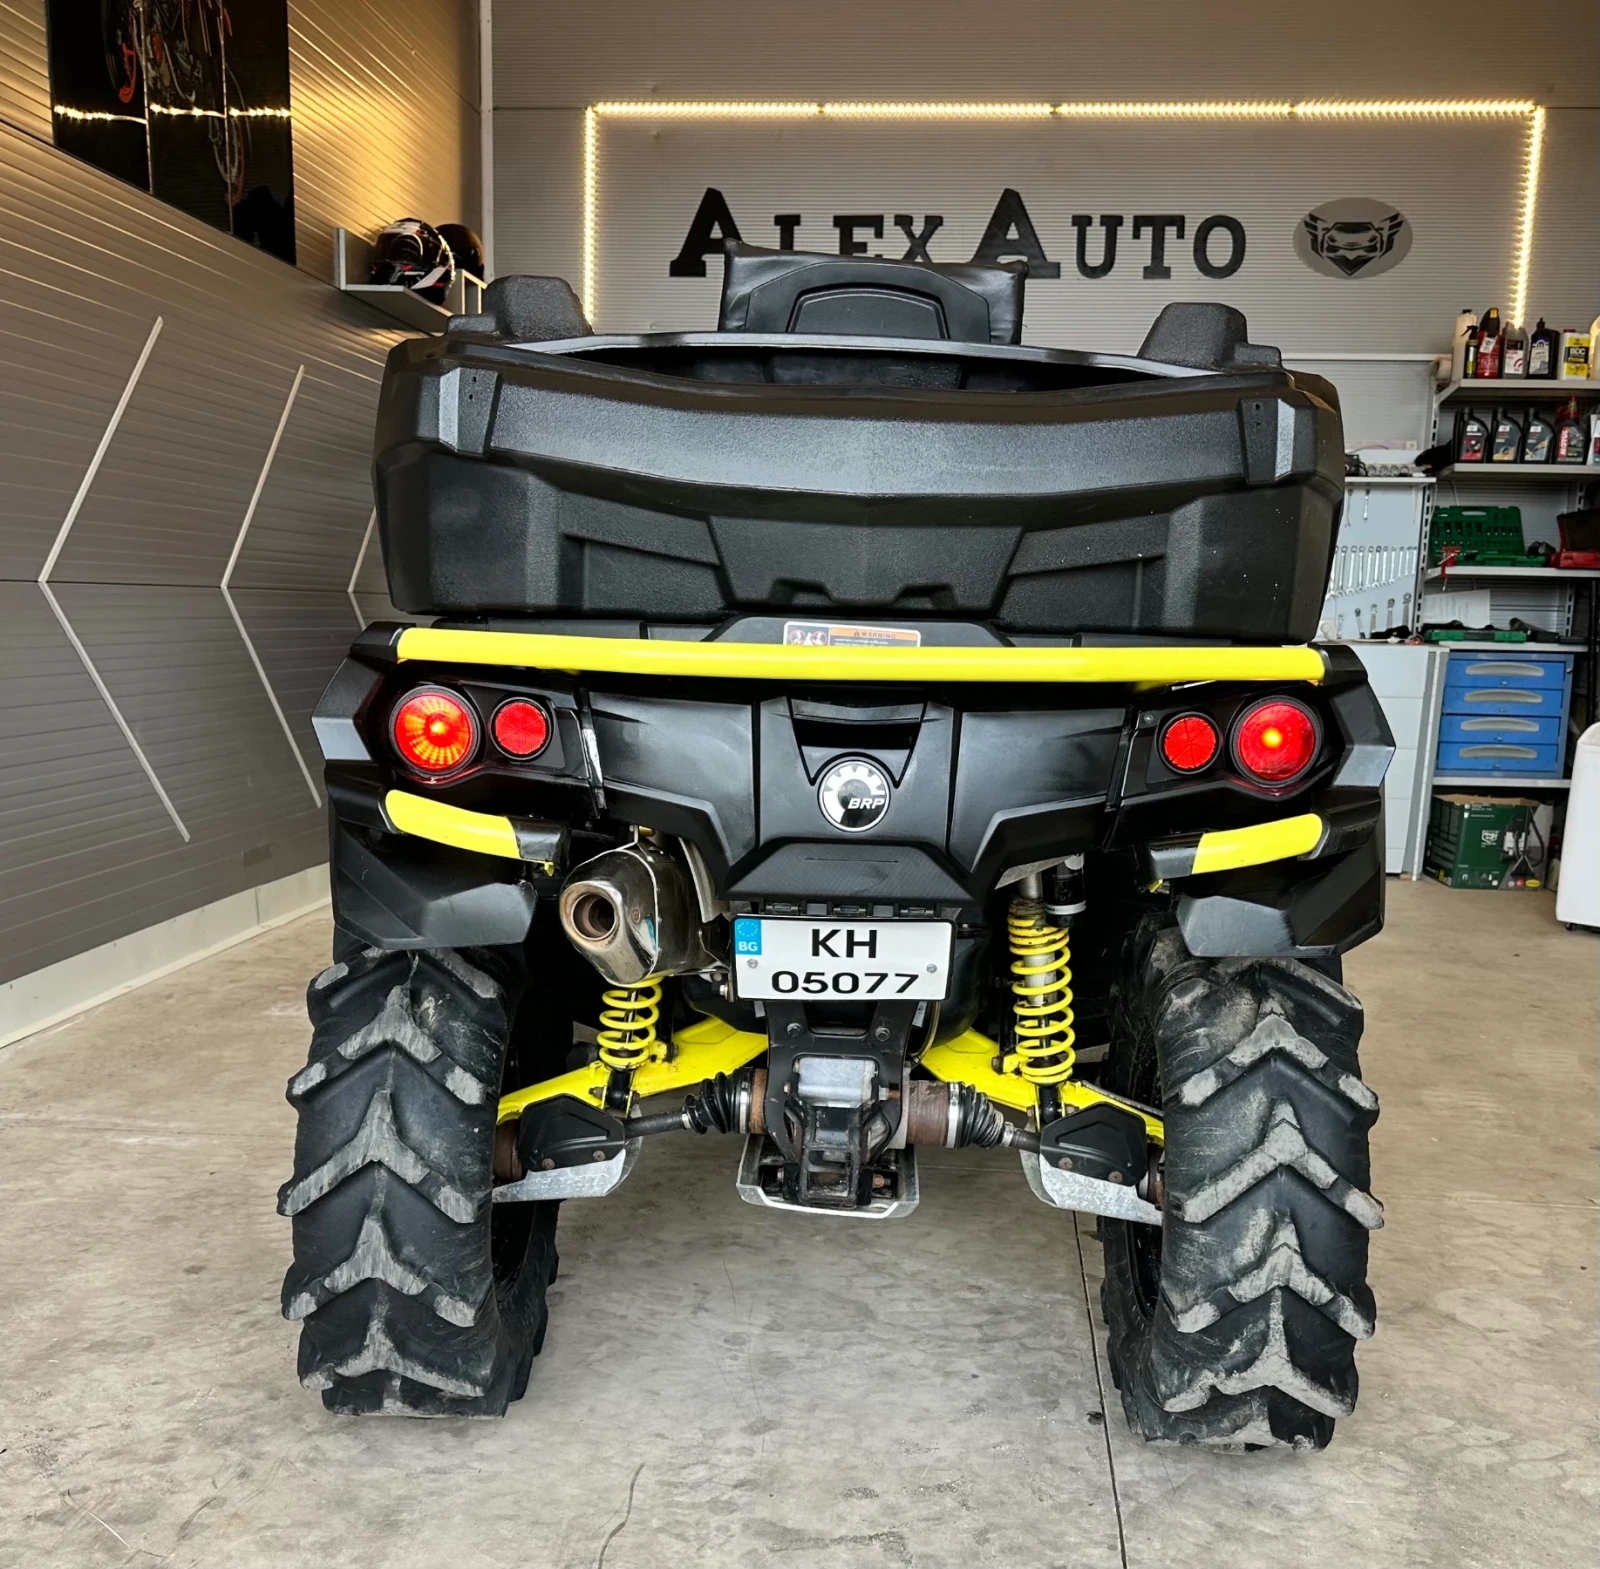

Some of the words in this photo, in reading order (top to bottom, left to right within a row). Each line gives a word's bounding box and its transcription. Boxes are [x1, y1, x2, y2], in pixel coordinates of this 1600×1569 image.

[1559, 429, 1568, 456] MOTUL
[860, 631, 896, 639] WARNING
[847, 798, 885, 809] BRP
[738, 941, 758, 952] BG
[811, 928, 877, 958] KH
[771, 970, 919, 994] 05077
